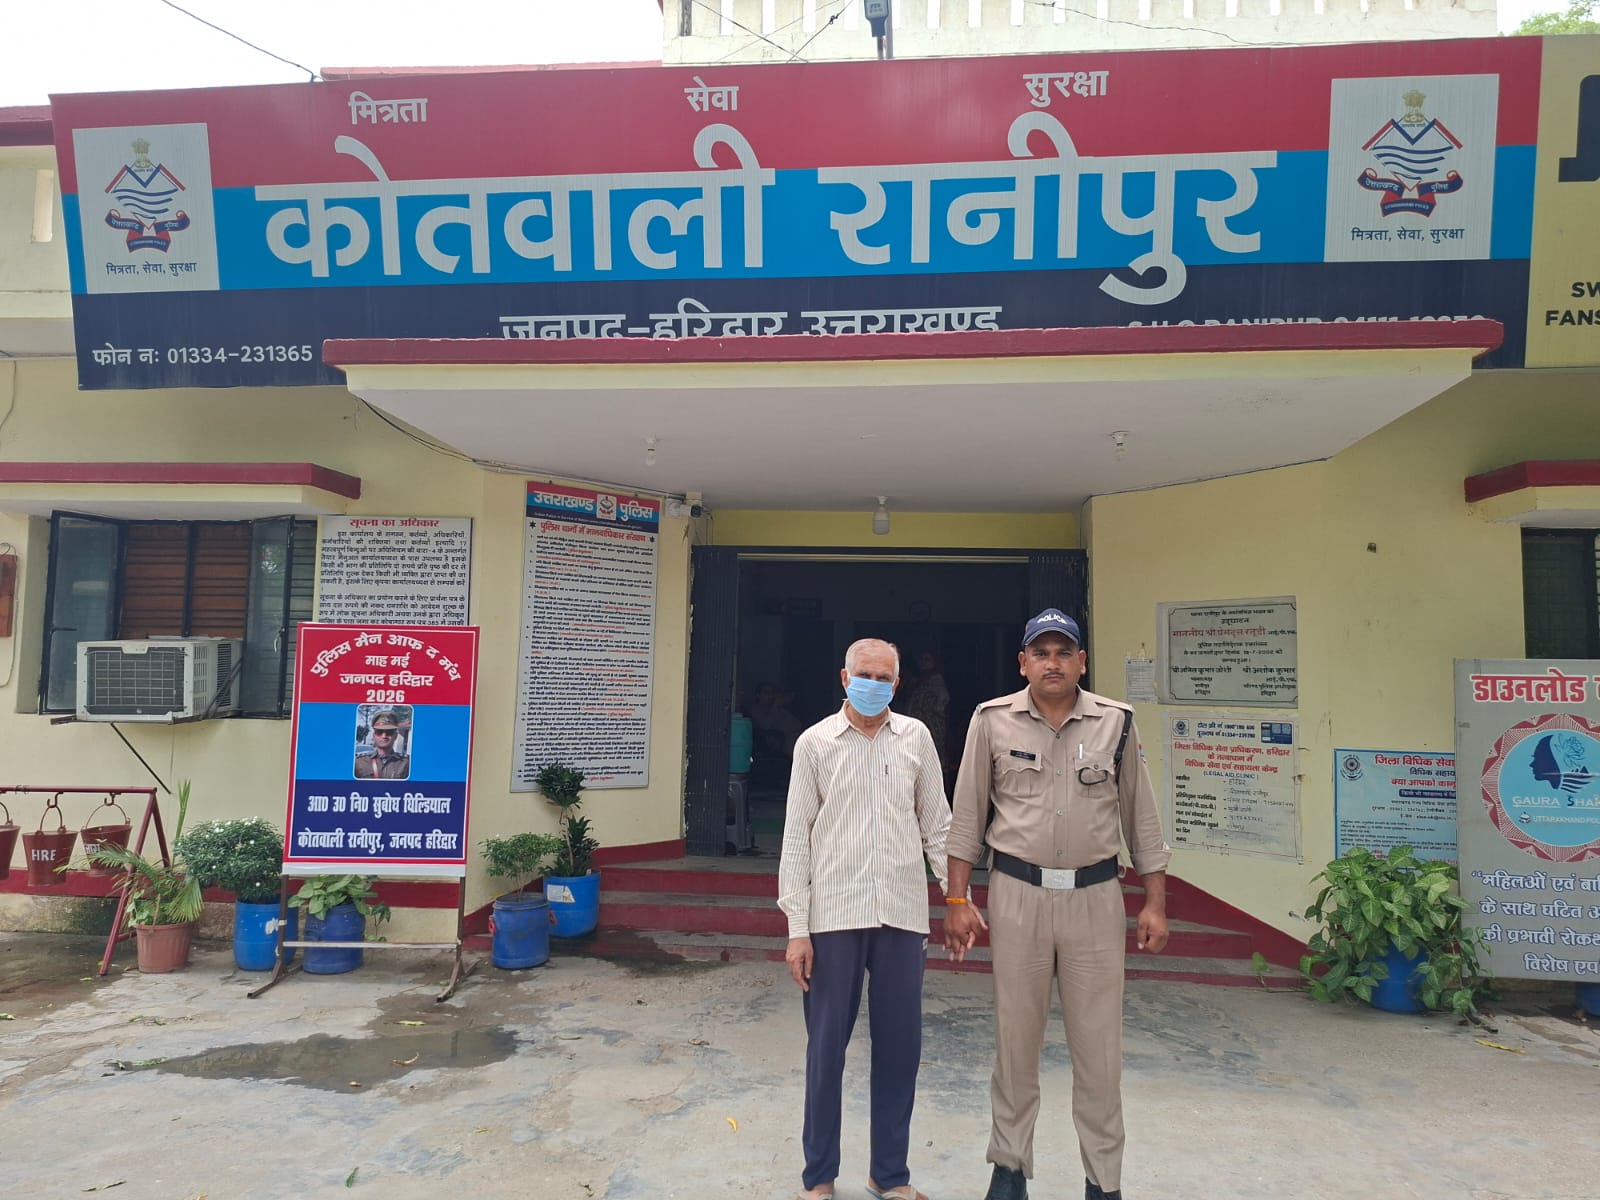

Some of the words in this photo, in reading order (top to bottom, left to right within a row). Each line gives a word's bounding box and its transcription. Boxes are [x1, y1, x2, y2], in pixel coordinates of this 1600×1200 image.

[685, 76, 740, 113] सेवा
[1022, 70, 1110, 107] सुरक्षा
[348, 92, 428, 126] मित्रता
[255, 123, 777, 279] कोतवाली
[817, 112, 1278, 305] रानीपुर
[1351, 227, 1392, 242] मित्रता,
[1397, 225, 1425, 242] सेवा,
[1430, 228, 1465, 244] सुरक्षा
[169, 261, 198, 276] सुरक्षा
[92, 342, 133, 366] फोन
[167, 345, 313, 365] 01334-231365
[533, 490, 595, 511] उत्तराखण्ड
[620, 500, 654, 521] पुलिस
[350, 518, 378, 529] सूचना
[382, 519, 396, 527] का
[399, 517, 440, 528] अधिकार
[310, 640, 352, 677] पुलिस
[354, 631, 383, 648] मैन
[387, 634, 424, 650] आफ
[425, 646, 440, 659] द
[438, 655, 462, 681] मंथ
[365, 655, 389, 667] माह
[390, 652, 411, 668] मई
[339, 673, 386, 685] जनपद
[388, 670, 434, 687] हरिद्वार
[1470, 667, 1589, 704] डाउनलोड
[366, 689, 405, 703] 2026
[1375, 754, 1400, 765] जिला
[1402, 755, 1432, 766] विधिक
[1512, 796, 1560, 806] GAURA
[298, 827, 345, 848] कोतवाली
[347, 827, 385, 854] रानीपुर,
[389, 832, 423, 849] जनपद
[425, 829, 458, 849] हरिद्वार
[31, 848, 57, 861] FIRE
[1551, 873, 1575, 892] एवं
[1479, 896, 1497, 914] के
[1501, 901, 1537, 916] साथ
[1541, 899, 1582, 918] घटित
[1506, 926, 1555, 944] प्रभावी
[1524, 952, 1569, 972] विशेष
